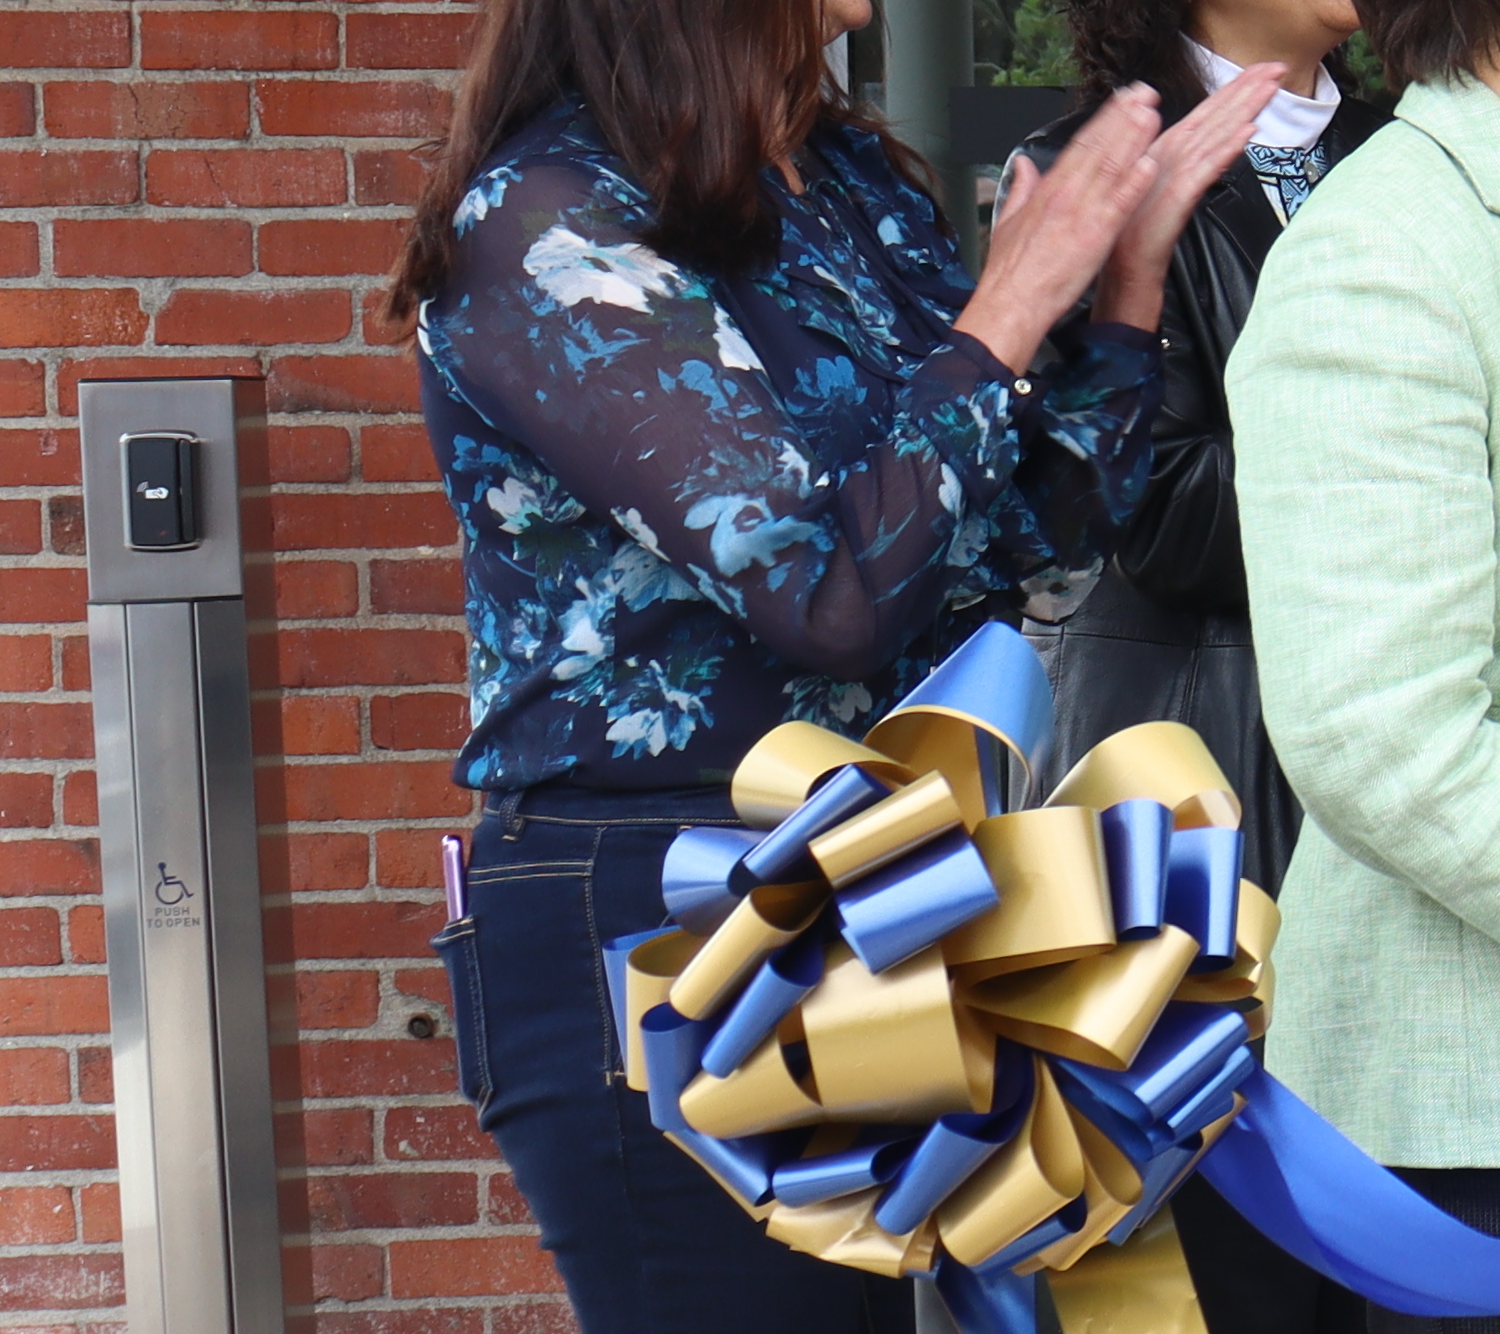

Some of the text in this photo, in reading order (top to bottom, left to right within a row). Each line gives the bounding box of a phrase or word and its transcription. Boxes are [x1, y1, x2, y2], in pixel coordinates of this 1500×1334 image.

[154, 906, 190, 917] PUSH
[146, 917, 201, 929] TO OPEN
